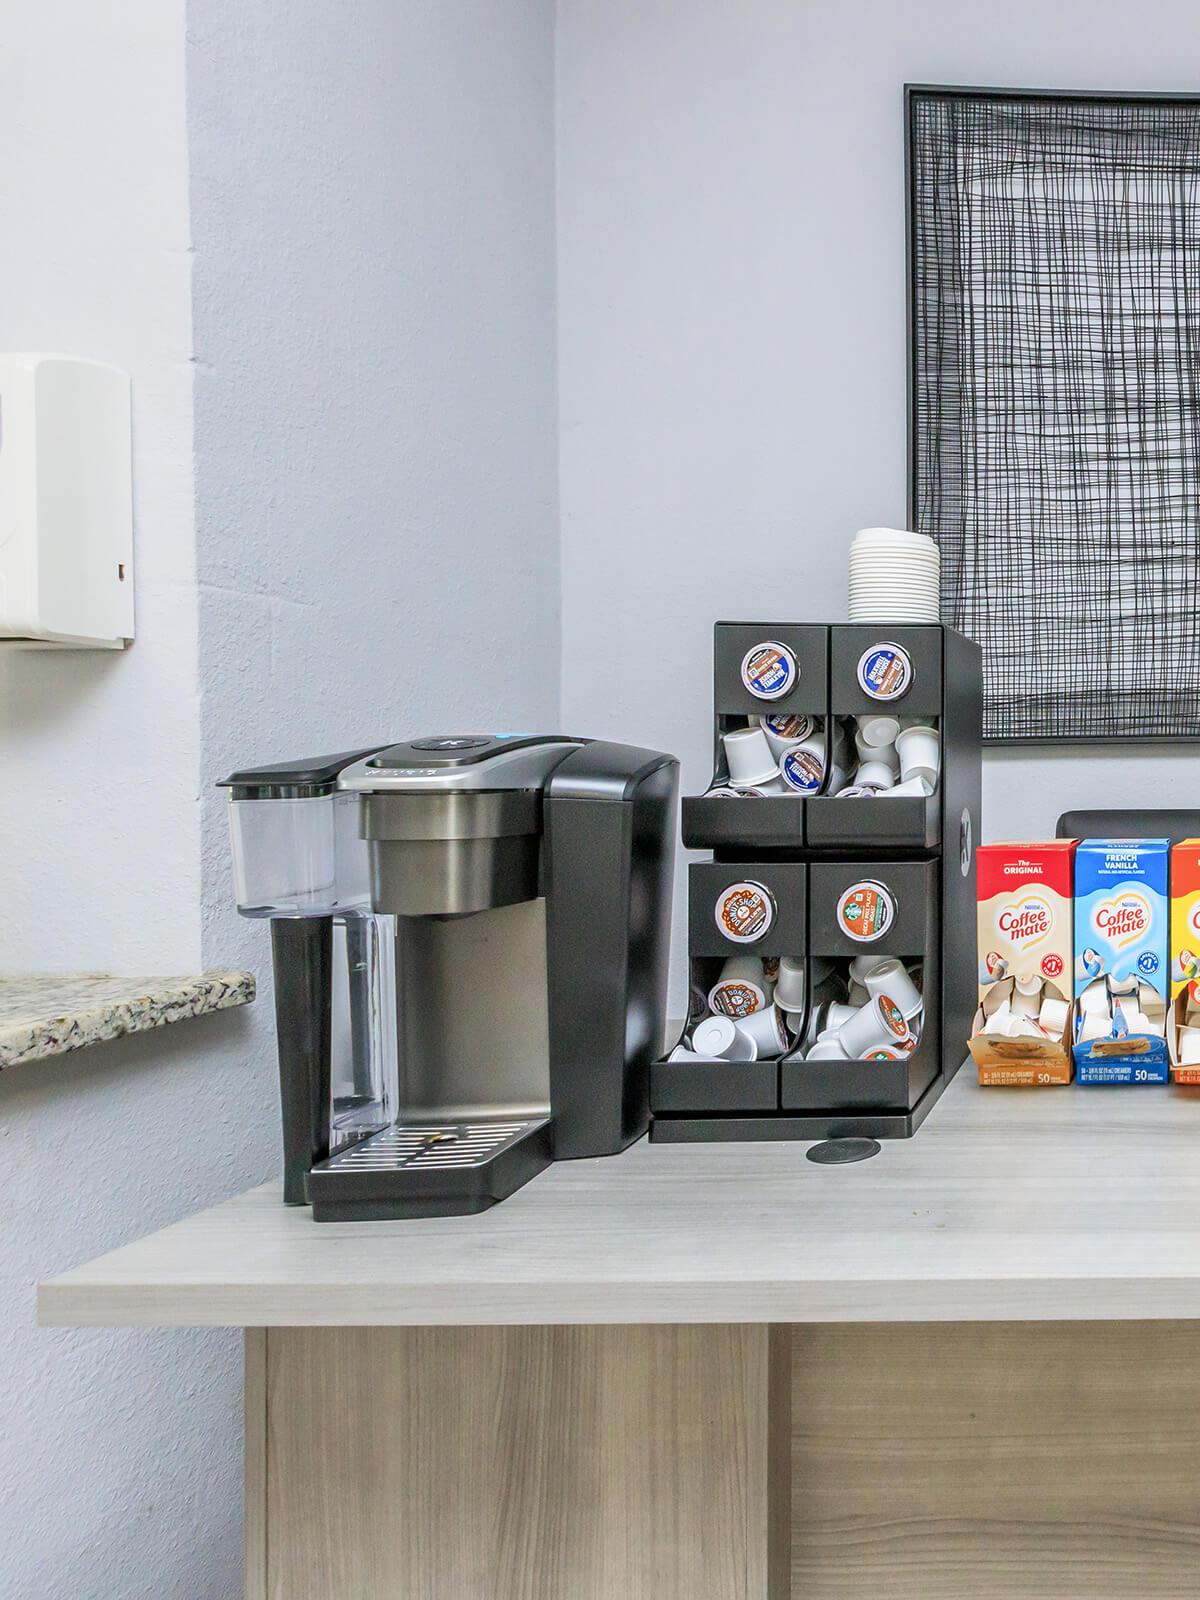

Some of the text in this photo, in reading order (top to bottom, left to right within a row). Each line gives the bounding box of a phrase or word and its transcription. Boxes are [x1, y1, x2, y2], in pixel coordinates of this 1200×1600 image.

[868, 656, 884, 681] MAXWELL
[878, 659, 890, 677] HOUSE
[999, 911, 1046, 931] Coffee
[1096, 908, 1143, 928] Coffee
[1011, 921, 1048, 941] mate
[1107, 919, 1144, 937] mate
[1038, 1073, 1050, 1083] 50
[1135, 1070, 1147, 1080] 50
